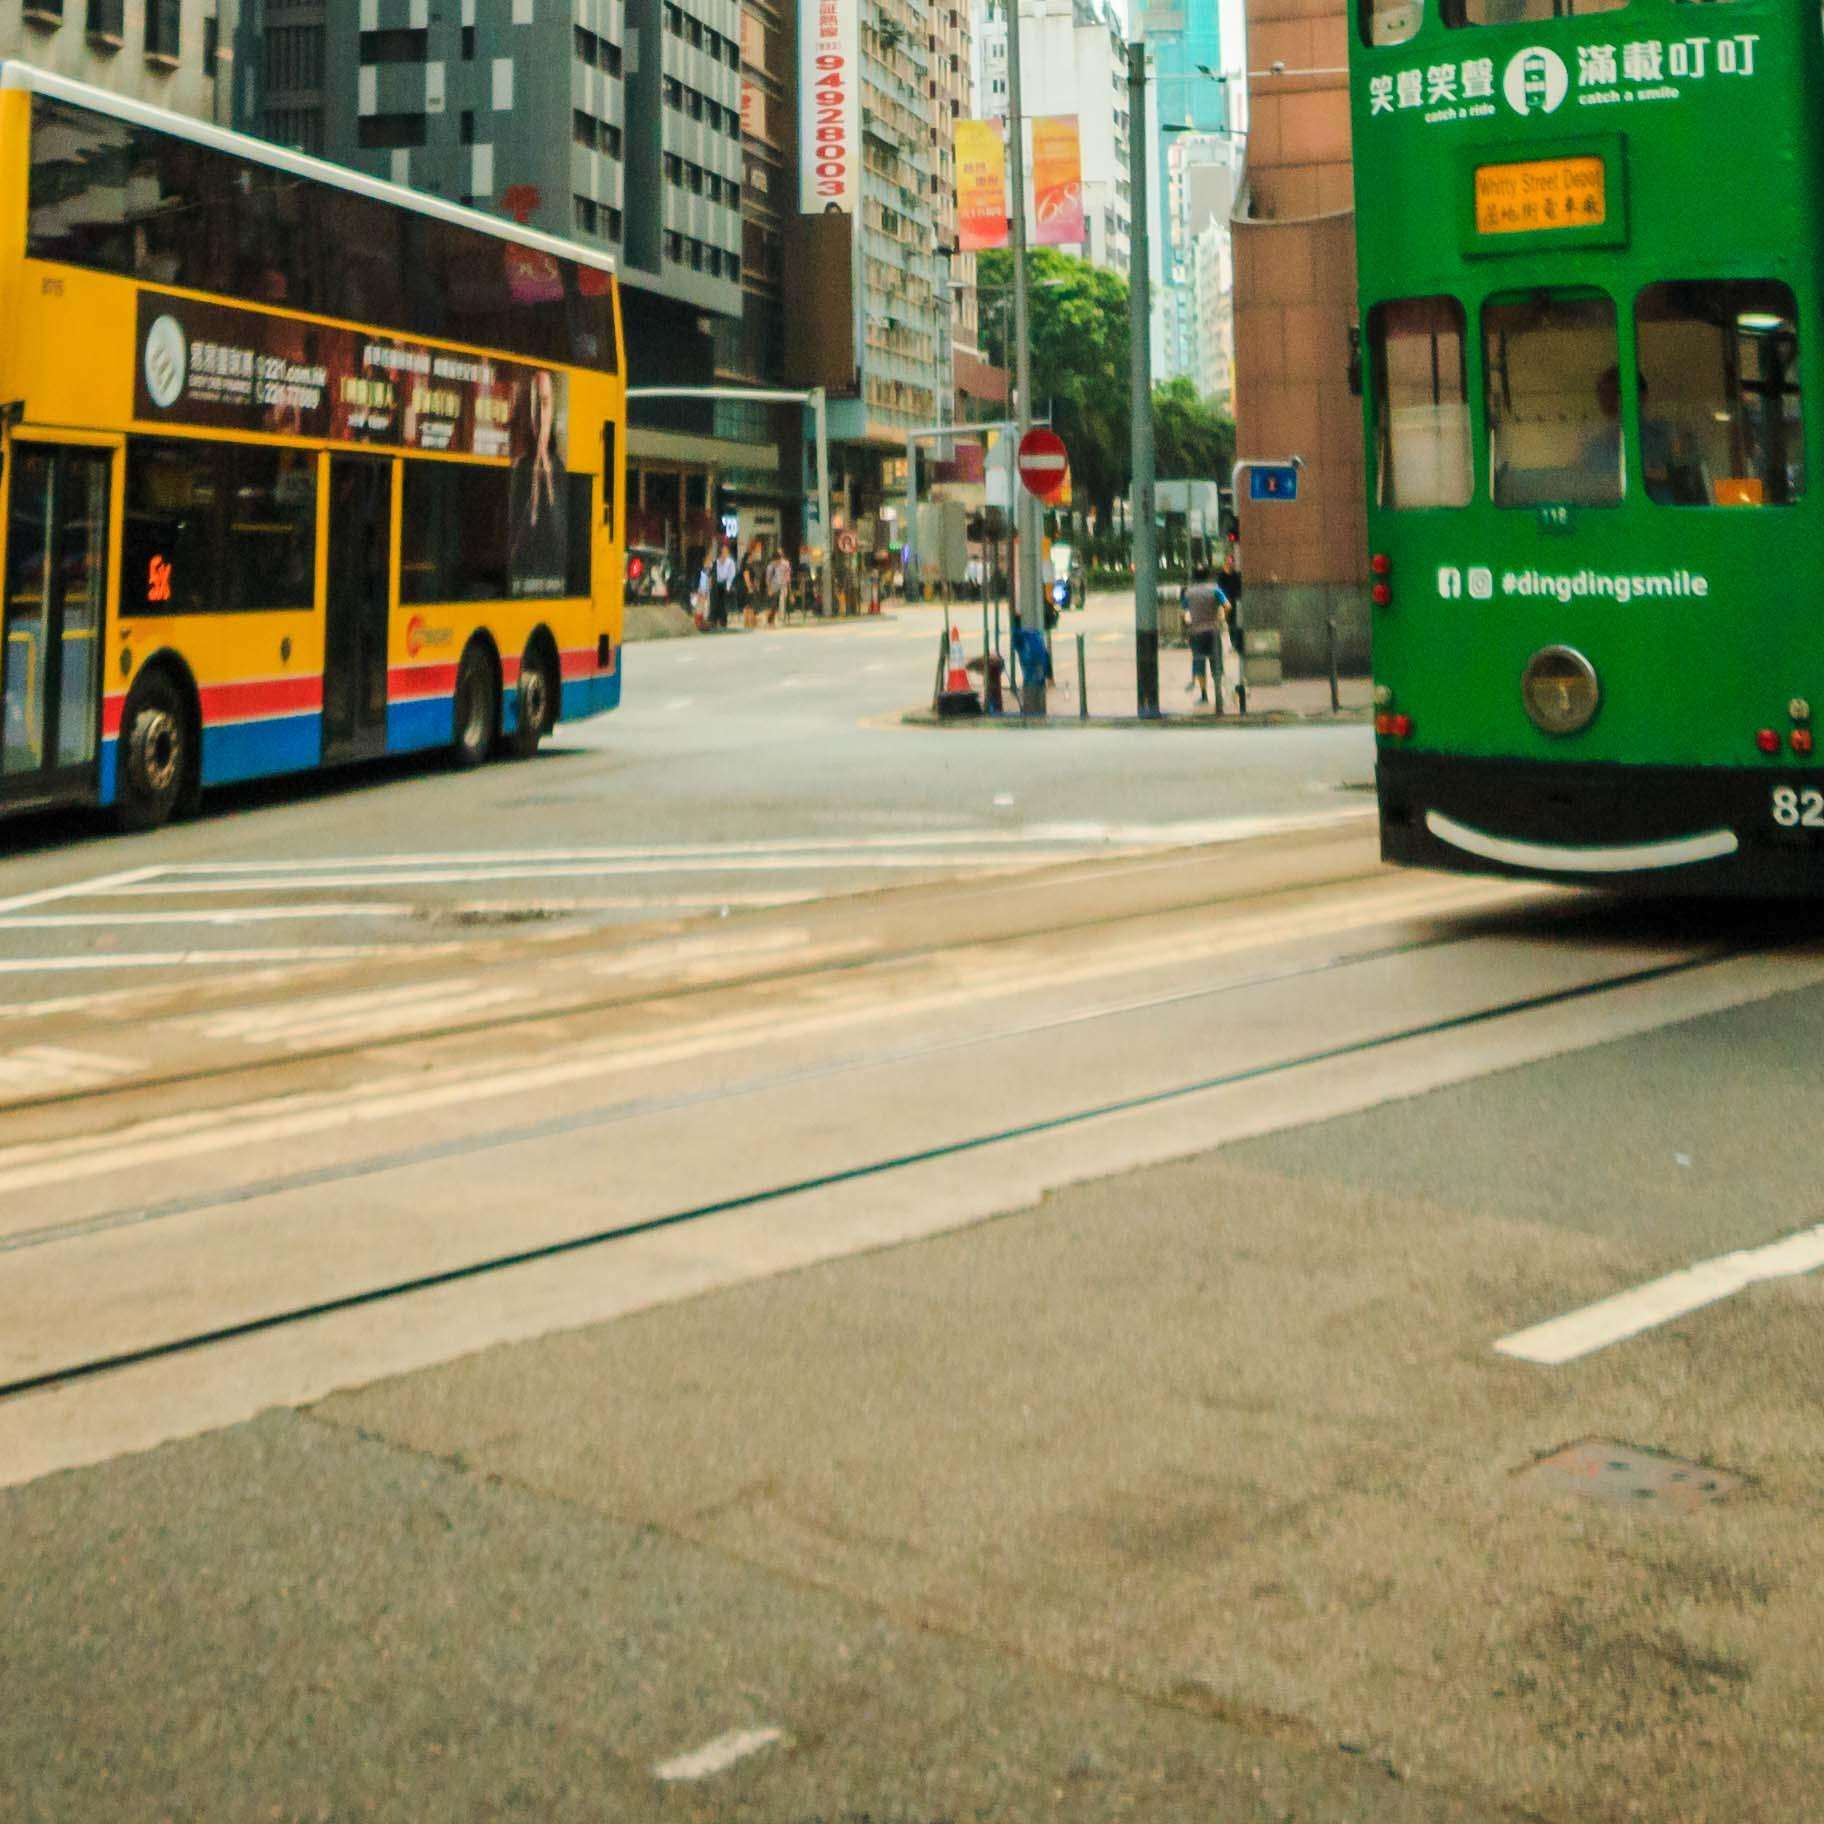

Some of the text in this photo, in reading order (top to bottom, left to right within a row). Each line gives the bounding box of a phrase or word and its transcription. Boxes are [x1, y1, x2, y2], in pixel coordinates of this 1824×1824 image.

[1369, 33, 1760, 116] 笑聲笑聲 滿載叮叮
[1579, 85, 1680, 106] catch a smile
[814, 54, 846, 197] 94928003
[1501, 569, 1709, 603] #dingdingsmile
